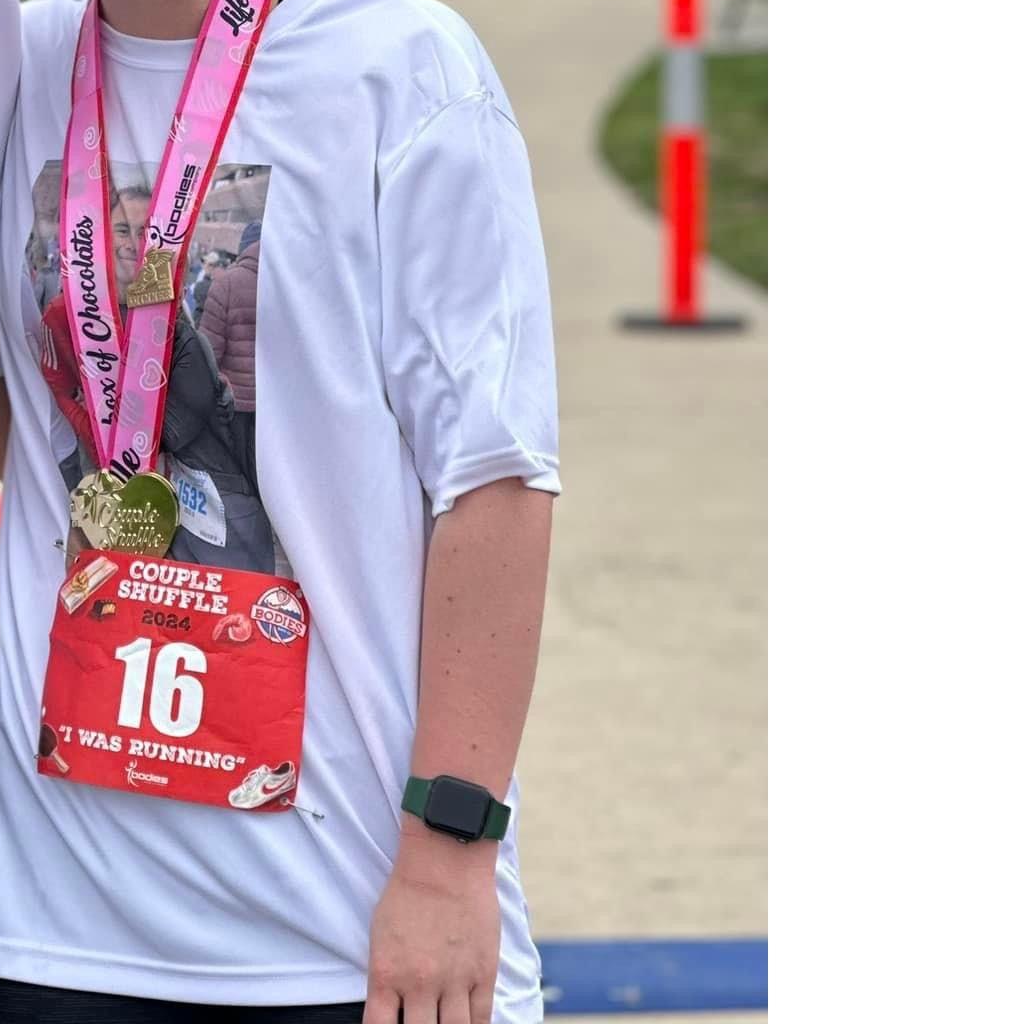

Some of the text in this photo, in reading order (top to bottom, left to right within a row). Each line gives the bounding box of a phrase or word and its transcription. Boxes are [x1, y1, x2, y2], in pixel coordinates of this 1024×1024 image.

[163, 163, 197, 237] bodies
[70, 215, 112, 342] Chocolates
[85, 348, 119, 372] of
[178, 479, 208, 516] 1532
[98, 501, 161, 529] Couple
[129, 560, 224, 592] COUPLE
[117, 579, 229, 615] SHUFFLE
[142, 608, 192, 632] 2024
[254, 607, 303, 634] BODIES
[114, 636, 209, 738] 16
[78, 728, 122, 753] WAS
